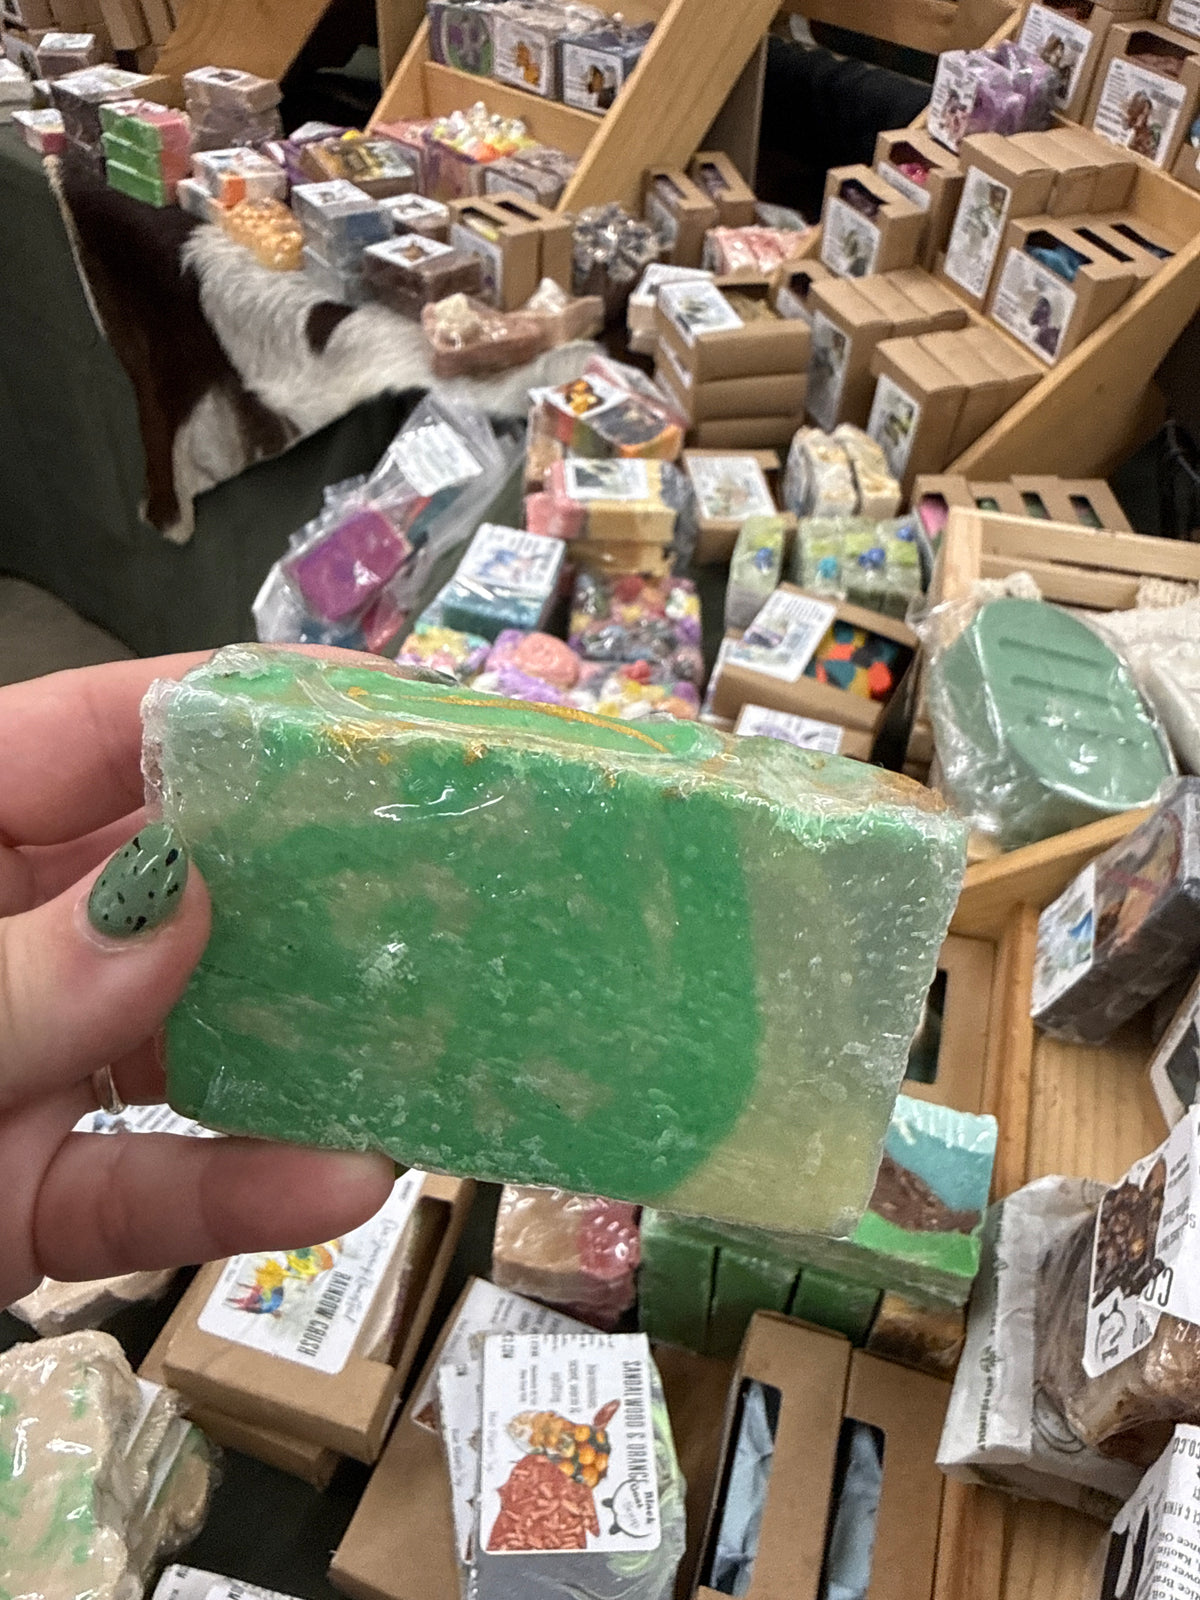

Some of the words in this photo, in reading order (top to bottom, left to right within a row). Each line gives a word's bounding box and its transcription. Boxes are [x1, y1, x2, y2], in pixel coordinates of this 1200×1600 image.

[315, 1271, 351, 1320] RAINBOW
[296, 1318, 329, 1357] CRUSH
[622, 1360, 646, 1428] SANDALWOOD
[626, 1431, 646, 1439] &
[643, 1490, 656, 1524] Black
[1177, 1534, 1200, 1553] nce
